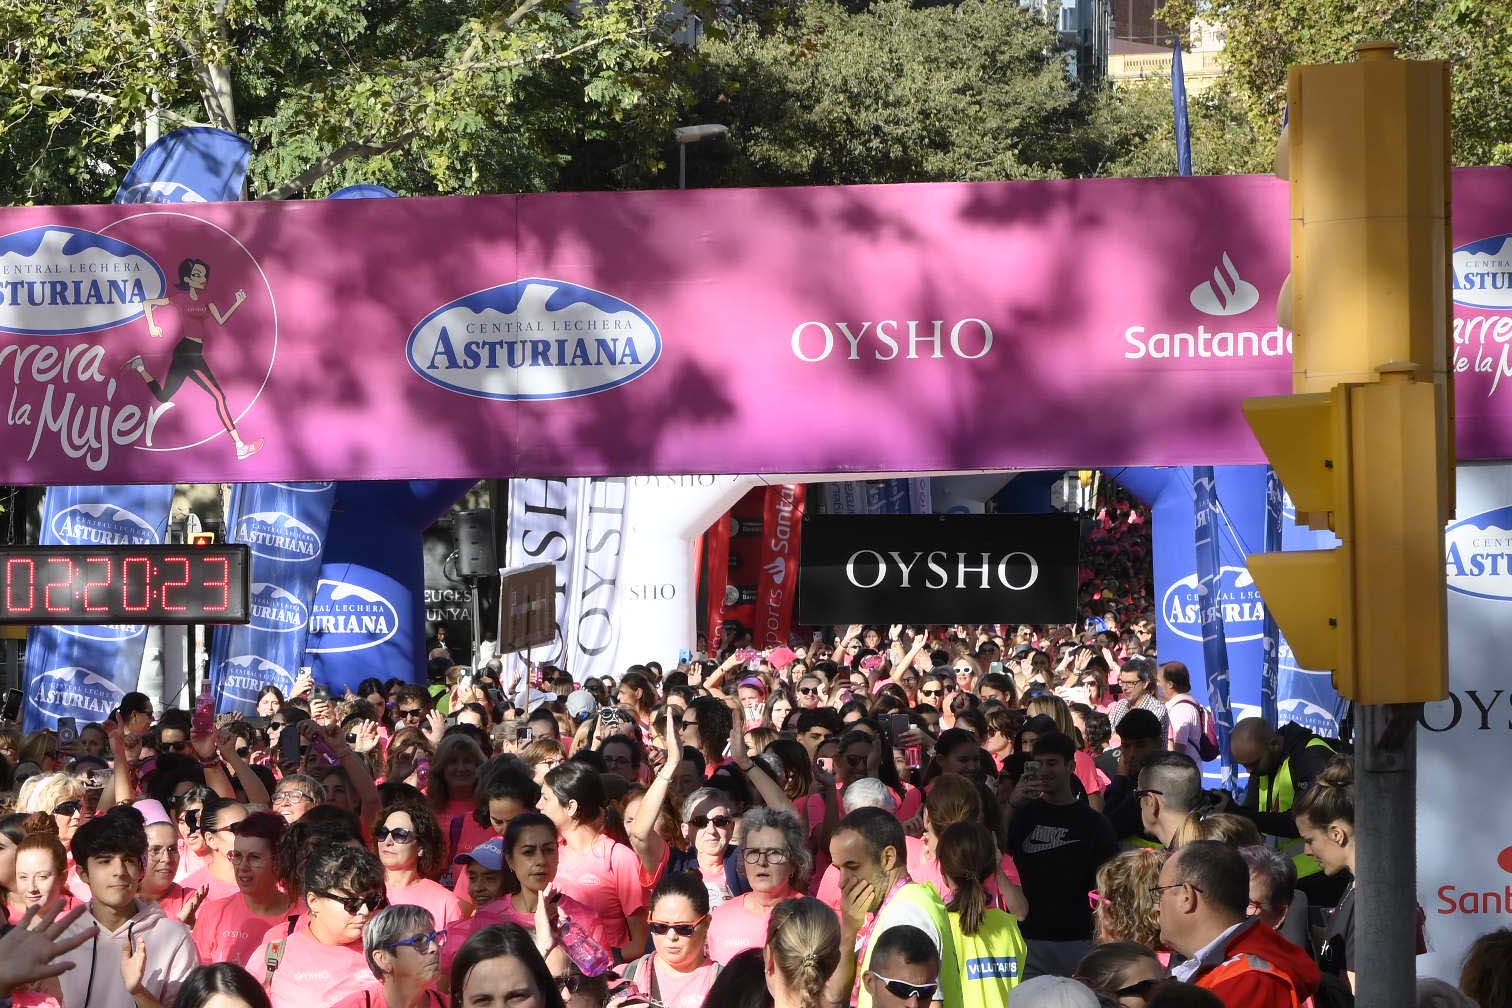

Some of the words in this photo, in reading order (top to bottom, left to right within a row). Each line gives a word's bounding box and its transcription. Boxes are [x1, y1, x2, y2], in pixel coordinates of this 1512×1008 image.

[69, 262, 141, 273] LECHERA
[466, 321, 544, 334] CENTRAL
[552, 319, 634, 332] LECHERA
[791, 318, 994, 362] OYSHO
[427, 325, 642, 370] ASTURIANA
[1475, 343, 1493, 373] la
[7, 387, 32, 426] la
[27, 377, 176, 472] Mujer
[238, 522, 315, 556] ASTURIANA
[6, 556, 229, 612] 02:20:23
[846, 549, 1039, 591] OYSHO
[336, 604, 384, 613] LECHERA
